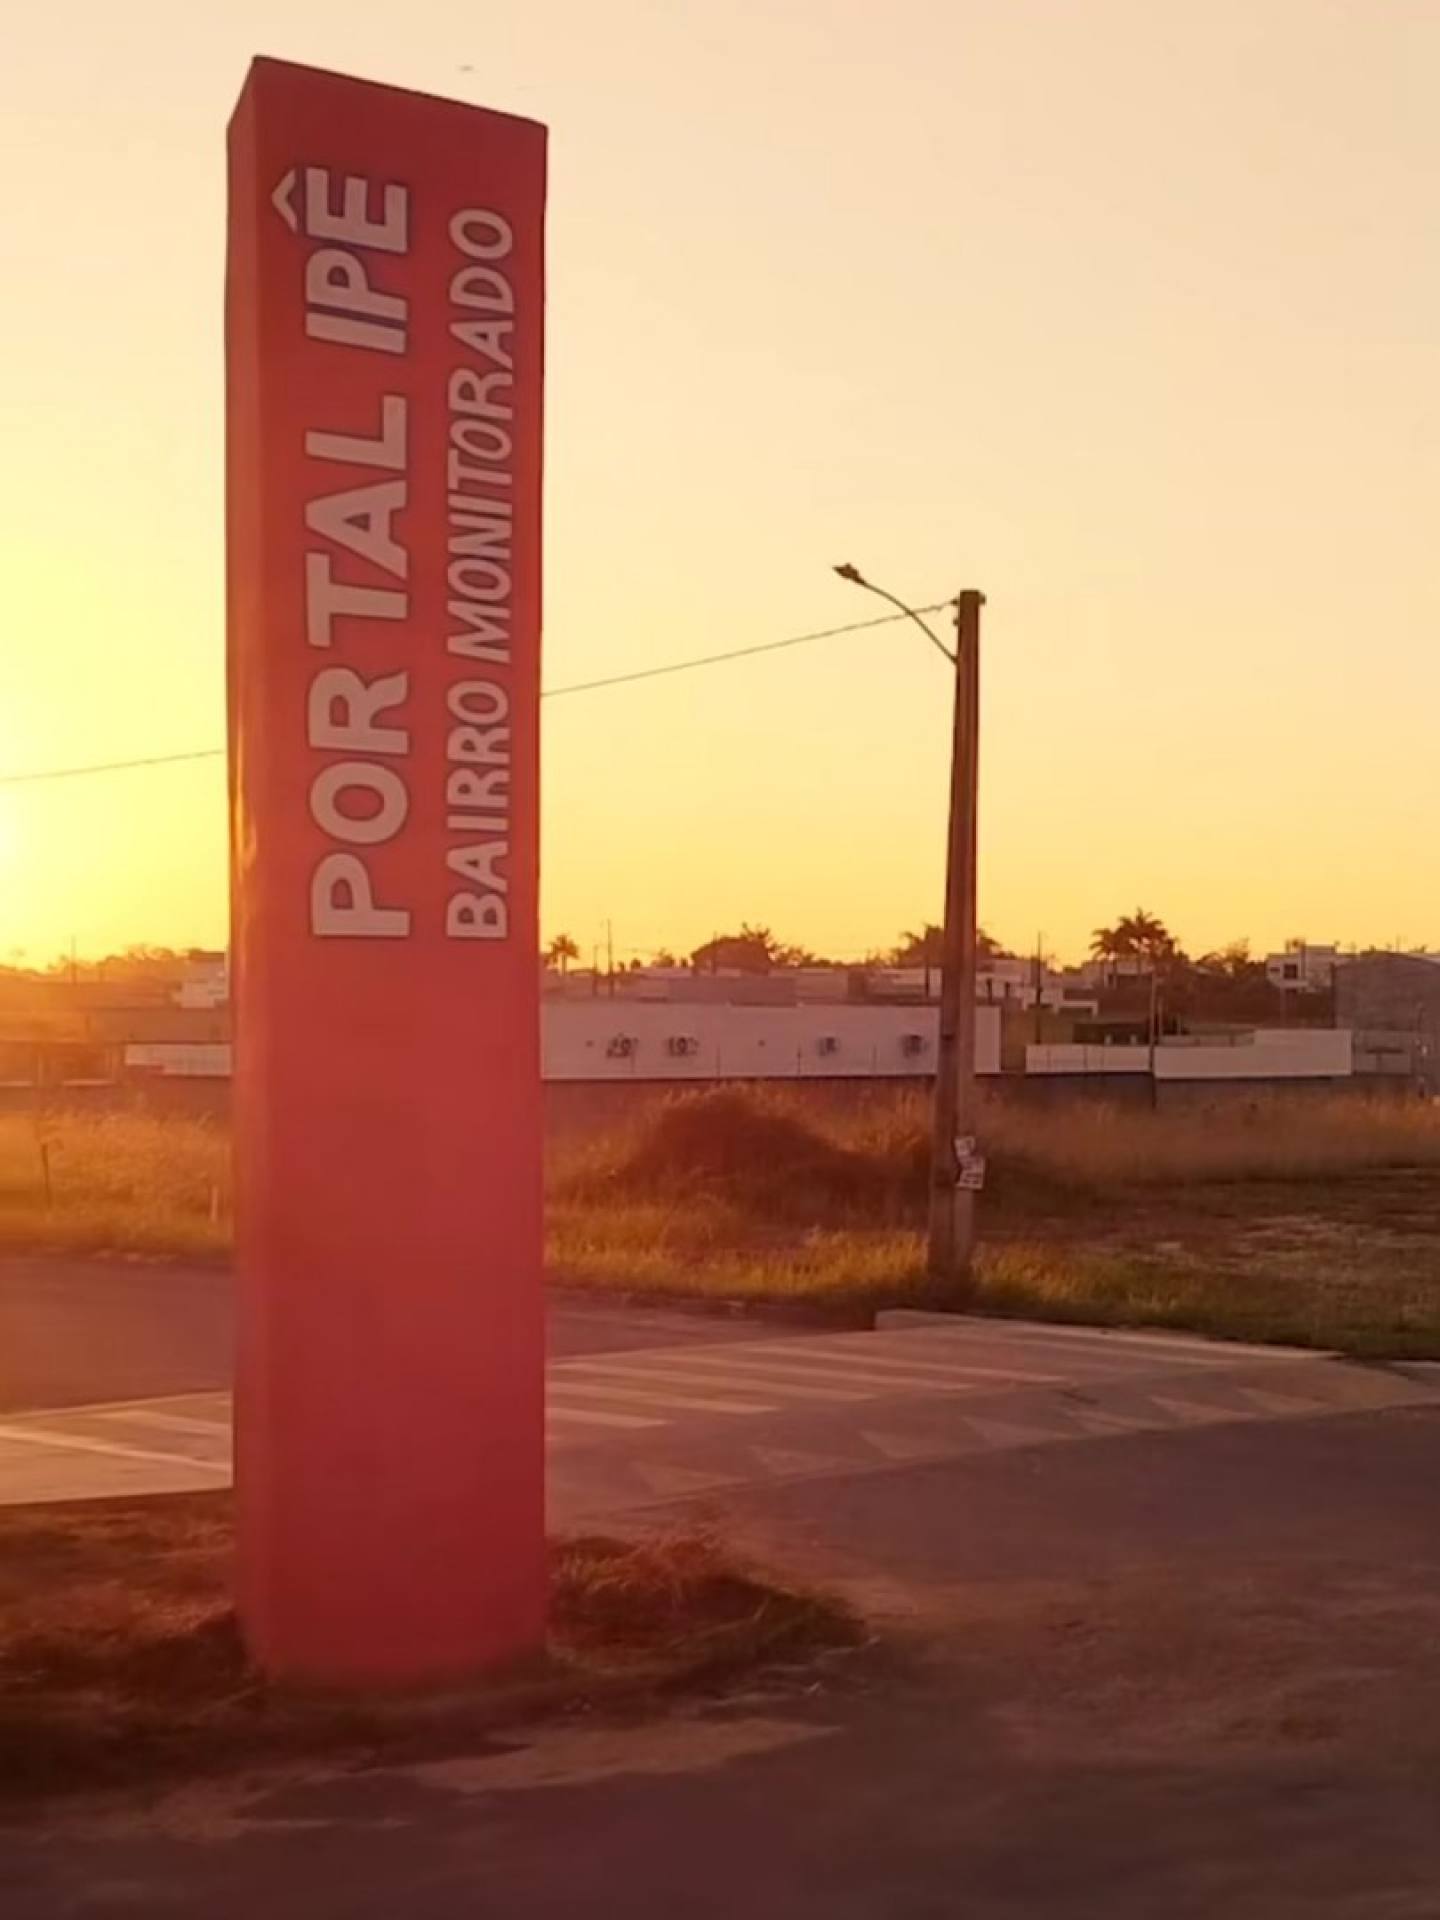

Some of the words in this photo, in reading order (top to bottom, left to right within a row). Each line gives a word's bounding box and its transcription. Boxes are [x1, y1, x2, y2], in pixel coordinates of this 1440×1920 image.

[272, 166, 408, 354] IPÊ
[447, 208, 514, 664] MONITORADO
[305, 393, 411, 937] PORTAL
[446, 680, 511, 939] BAIRRO
